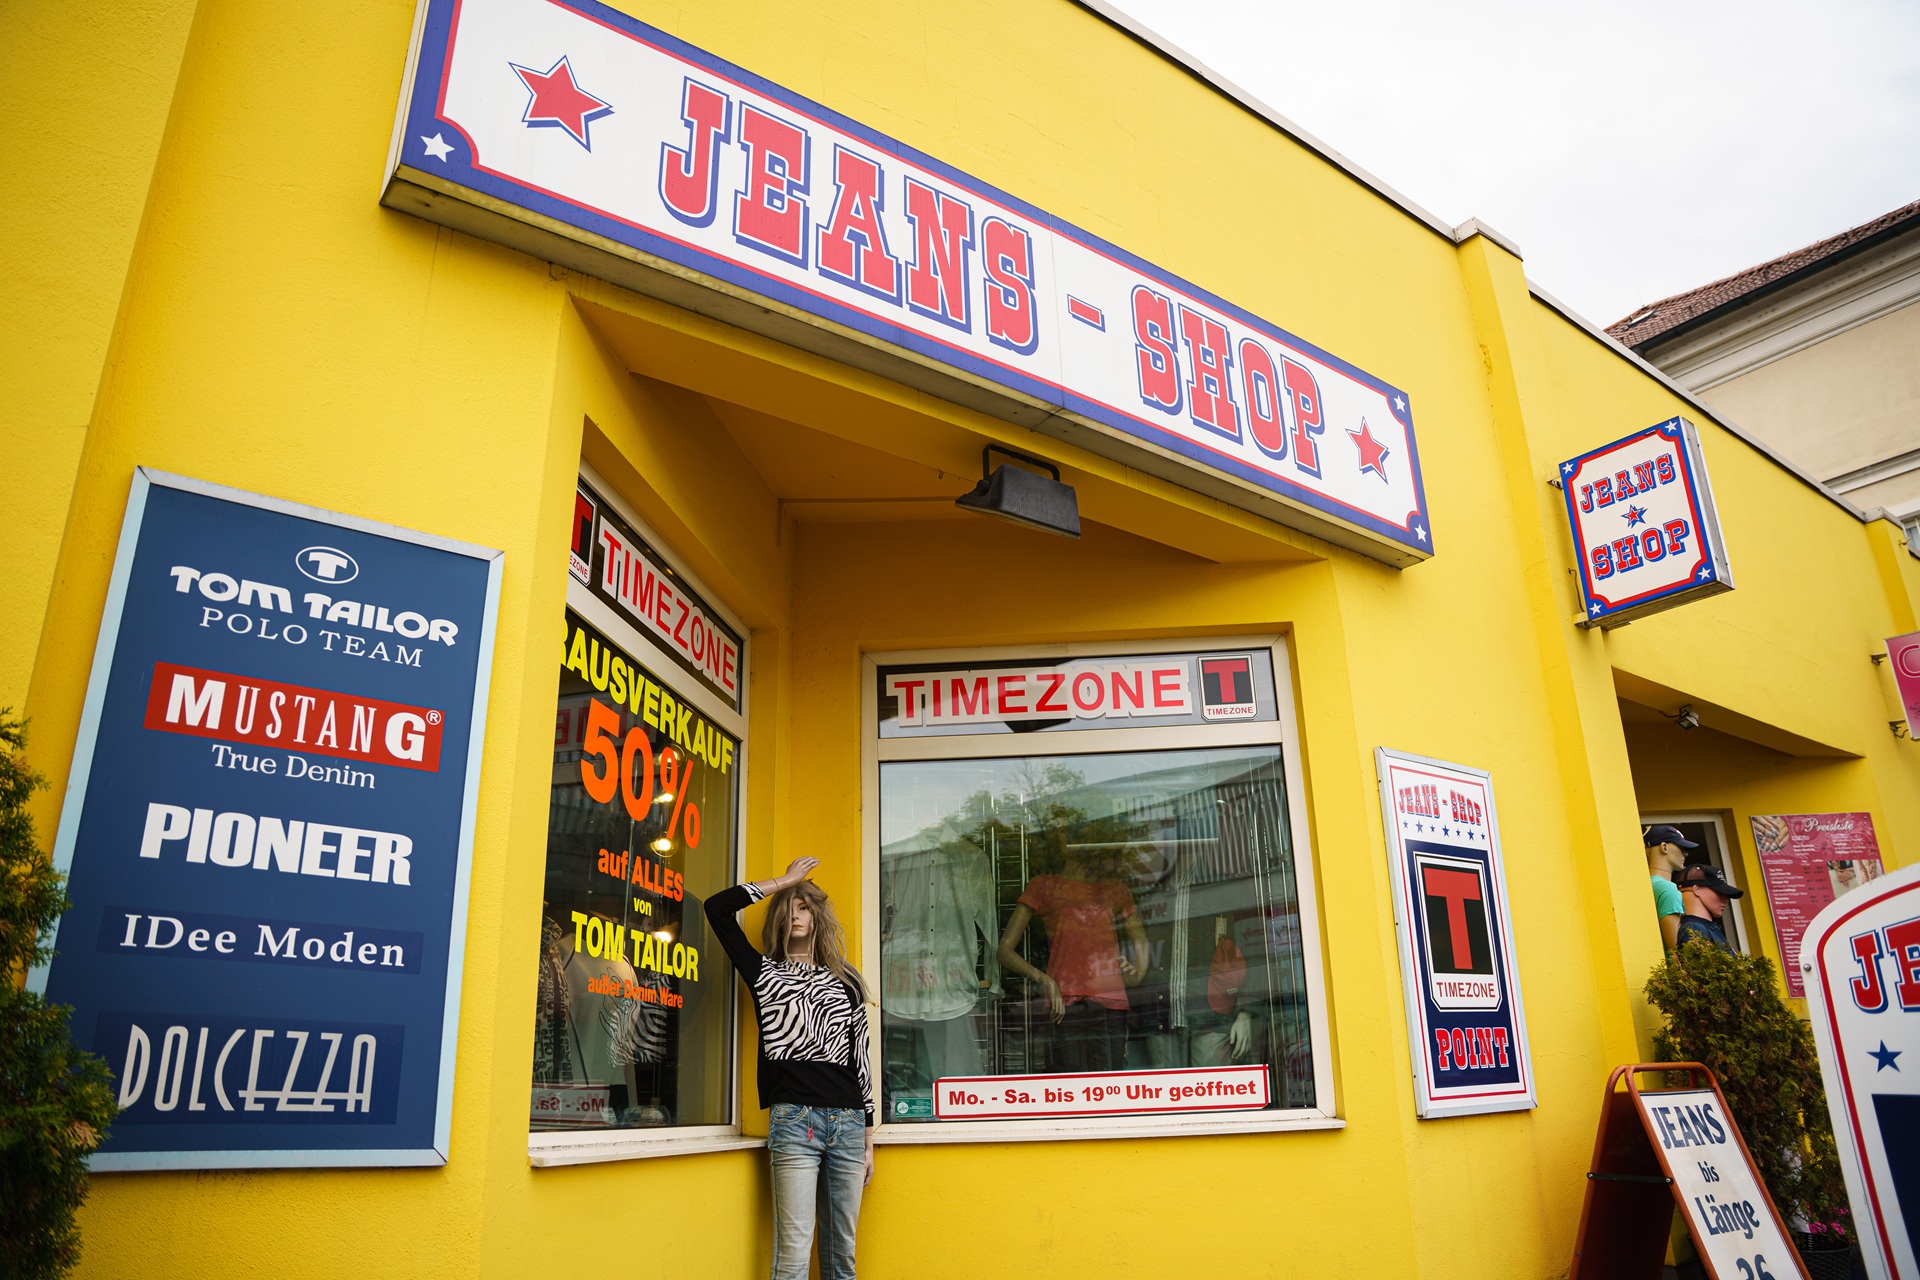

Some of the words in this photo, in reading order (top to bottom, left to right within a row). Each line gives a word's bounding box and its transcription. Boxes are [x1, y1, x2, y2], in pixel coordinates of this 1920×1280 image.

[658, 76, 1040, 356] JEANS
[1131, 284, 1325, 480] SHOP
[1580, 453, 1676, 514] JEANS
[1591, 518, 1690, 581] SHOP
[170, 566, 292, 613] TOM
[304, 593, 459, 646] TAILOR
[604, 529, 735, 691] TIMEZONE
[199, 607, 307, 645] POLO
[319, 630, 422, 667] TEAM
[894, 669, 1185, 719] TIMEZONE
[1203, 659, 1248, 703] T
[1207, 706, 1253, 715] TIMEZONE
[212, 744, 276, 775] True
[285, 756, 376, 788] Denim
[581, 697, 700, 849] 50%
[1399, 784, 1440, 819] JEANS
[1450, 789, 1482, 826] SHOP
[1803, 817, 1854, 832] Preisliste
[139, 802, 413, 886] PIONEER
[597, 848, 628, 880] auf
[631, 856, 684, 902] ALLES
[633, 897, 652, 916] von
[1423, 867, 1481, 970] T
[120, 914, 236, 953] IDee
[254, 924, 405, 967] Moden
[571, 910, 624, 963] TOM
[631, 929, 698, 982] TAILOR
[588, 974, 622, 997] außer
[624, 978, 656, 1004] Denim
[660, 986, 683, 1008] Ware
[1436, 982, 1496, 998] TIMEZONE
[118, 1023, 376, 1112] DOLCEZZA
[1435, 1026, 1510, 1071] POINT
[950, 1090, 985, 1105] Mo.
[1005, 1089, 1036, 1104] Sa.
[1045, 1087, 1074, 1102] bis
[1126, 1083, 1161, 1100] Uhr
[1169, 1080, 1256, 1101] geöffnet
[1651, 1103, 1726, 1150] JEANS
[1697, 1161, 1720, 1184] bis
[1694, 1194, 1760, 1239] Länge
